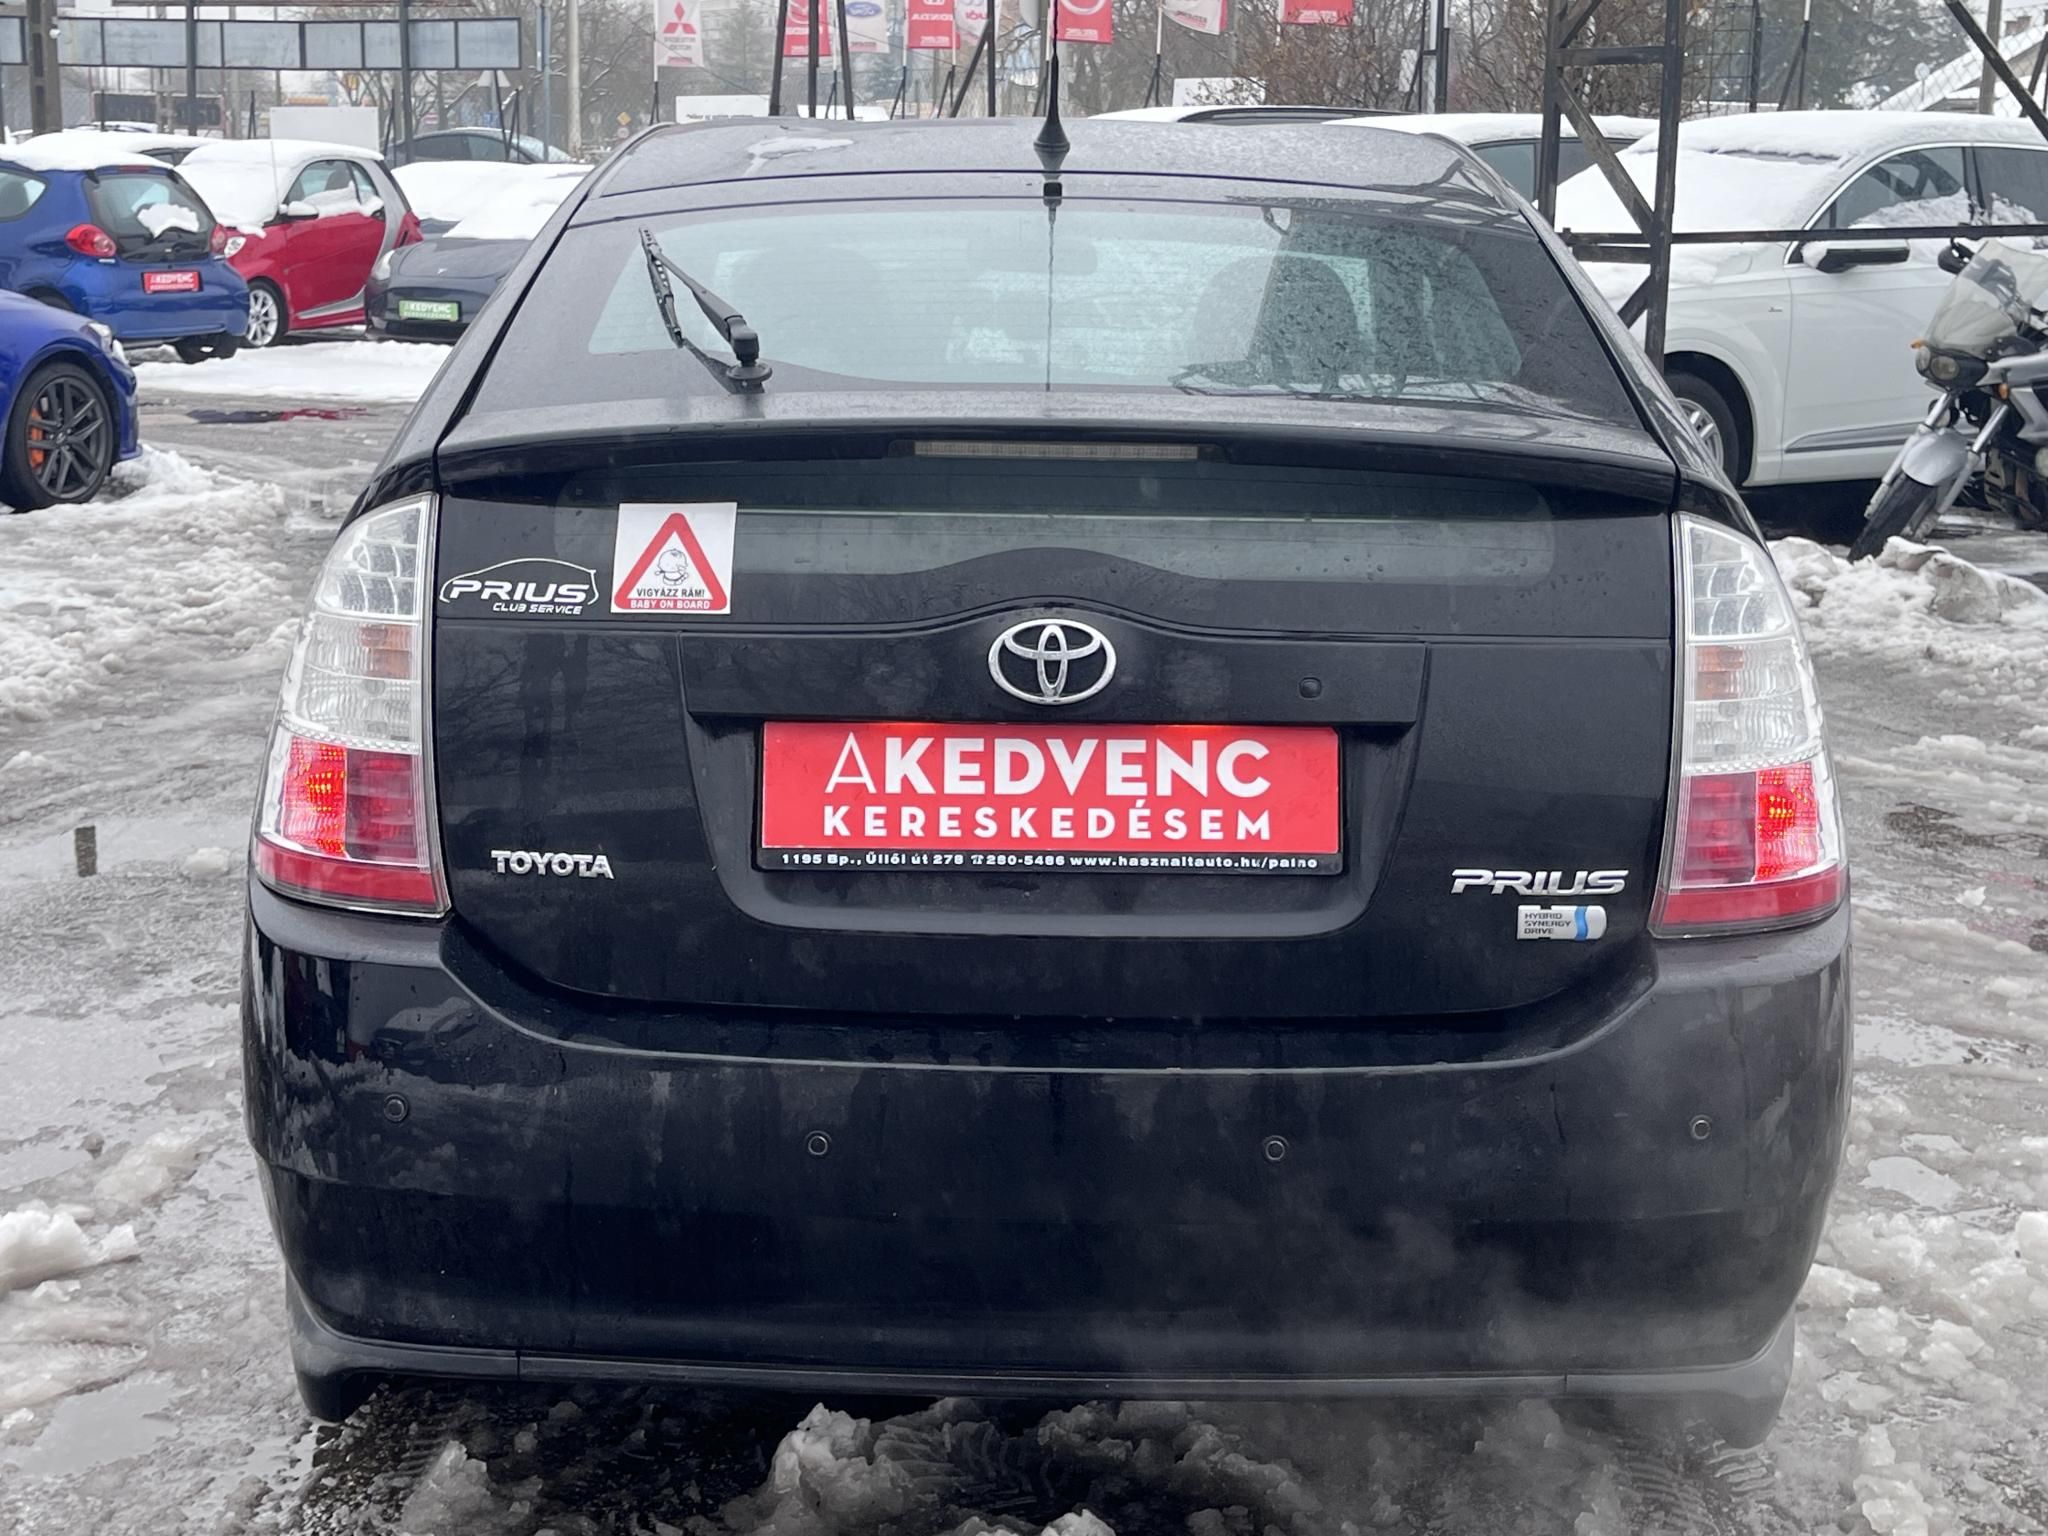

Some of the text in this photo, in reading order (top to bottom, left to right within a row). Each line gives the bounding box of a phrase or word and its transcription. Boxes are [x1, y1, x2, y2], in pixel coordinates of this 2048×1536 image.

[450, 580, 590, 605] PRIUS
[636, 586, 705, 597] VIGYÁZZ RÁM!
[493, 602, 583, 615] CLUB SERVICE
[630, 600, 711, 609] BABY ON BOARD
[823, 799, 1270, 840] KERESKEDÉSEM
[491, 850, 614, 879] TOYOTA
[782, 853, 822, 864] 1195
[911, 852, 928, 865] út
[1451, 869, 1629, 895] PRIUS
[1524, 912, 1563, 920] HYBRID
